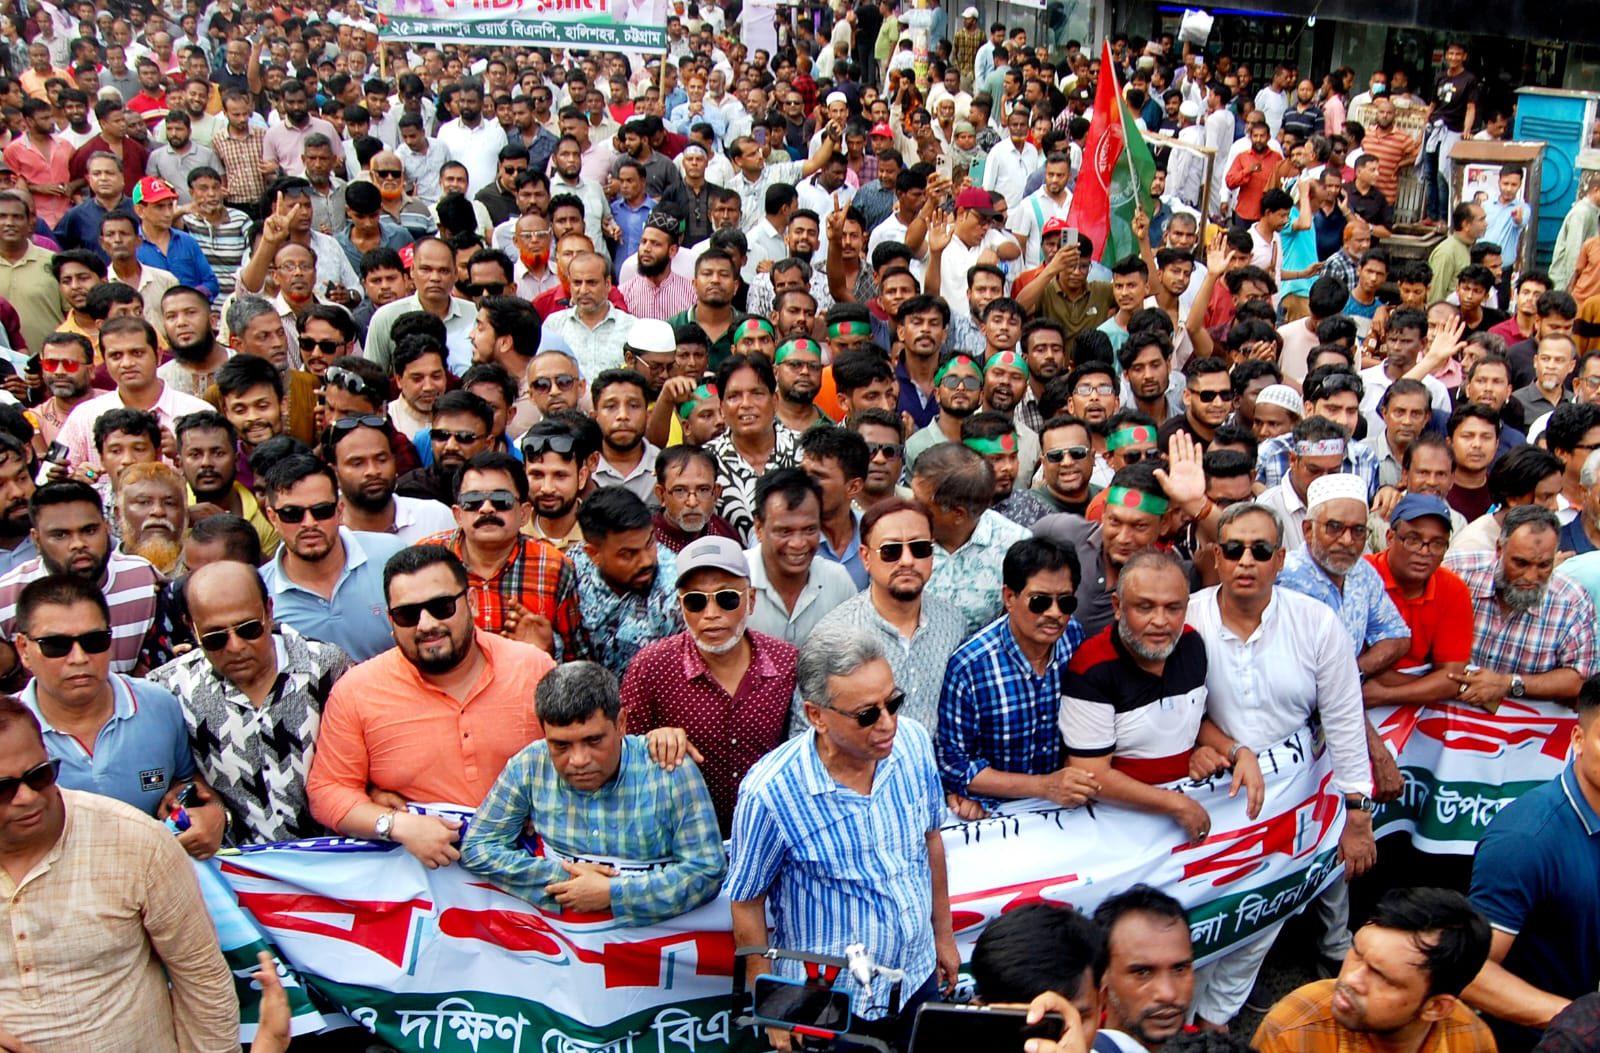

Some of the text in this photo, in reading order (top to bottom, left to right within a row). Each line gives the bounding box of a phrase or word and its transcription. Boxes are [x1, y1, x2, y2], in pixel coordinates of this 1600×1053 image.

[391, 20, 410, 36] ২৫
[475, 19, 508, 37] ওয়ার্ড
[395, 997, 531, 1053] দক্ষিণ
